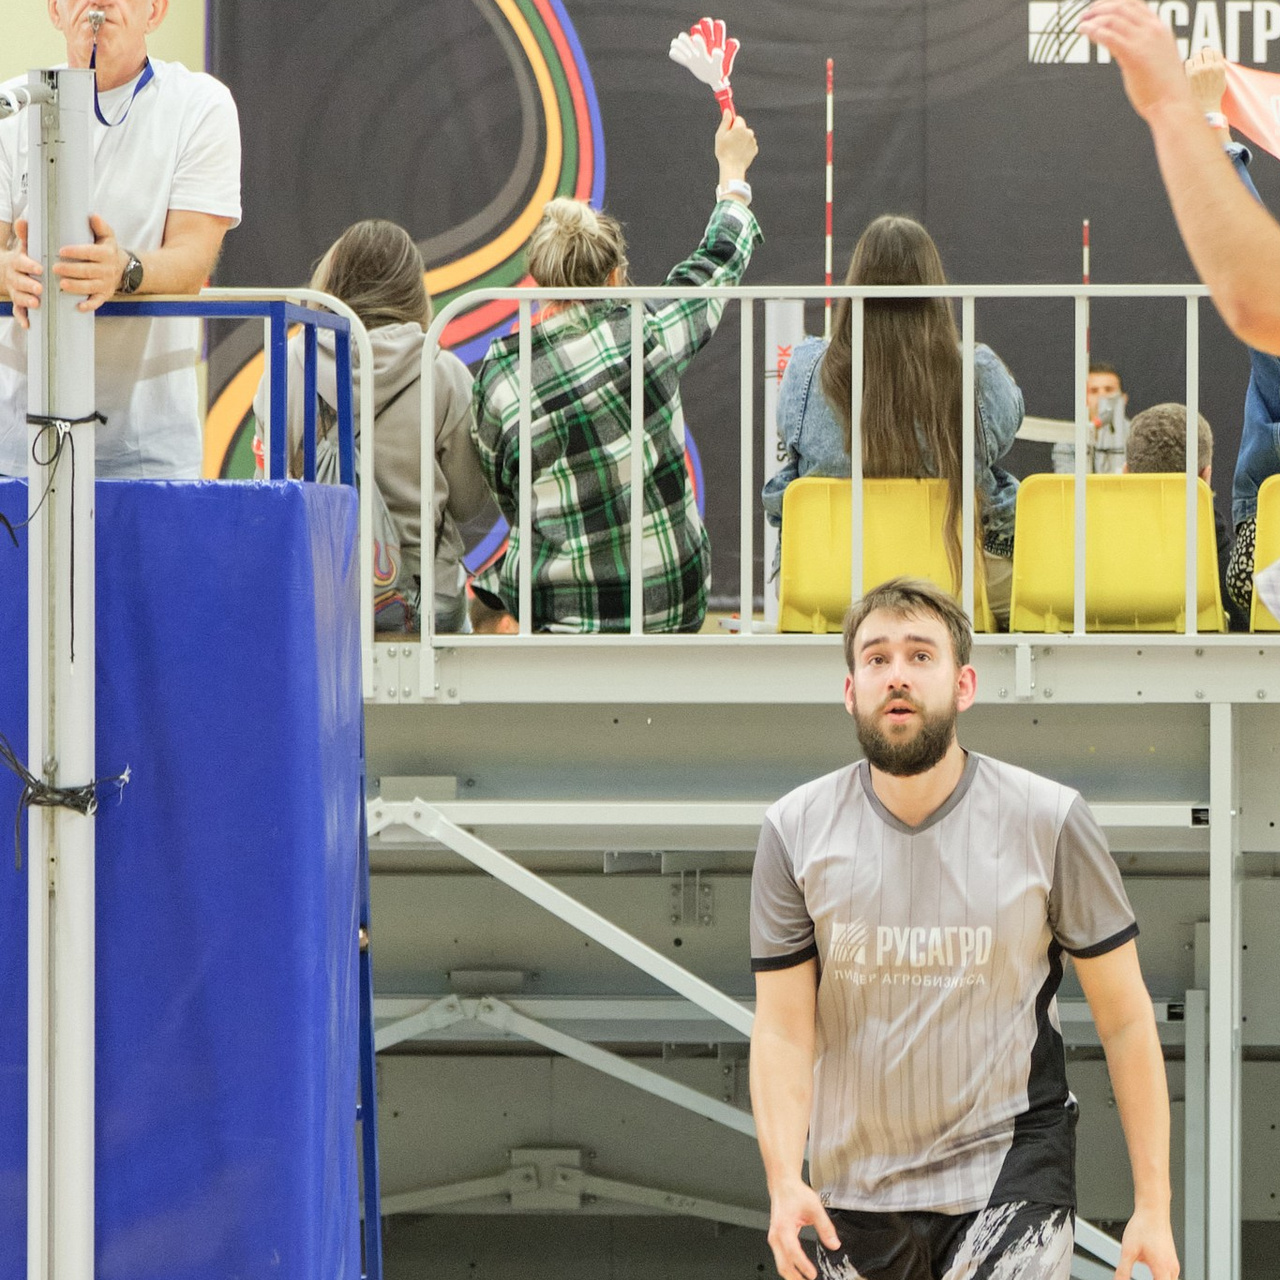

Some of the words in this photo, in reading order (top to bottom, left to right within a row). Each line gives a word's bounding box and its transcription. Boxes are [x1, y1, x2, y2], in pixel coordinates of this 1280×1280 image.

[877, 925, 992, 967] РУСАГРО
[834, 970, 876, 986] ЛИДЕР
[882, 973, 985, 988] АГРОБИЗНЕСА
